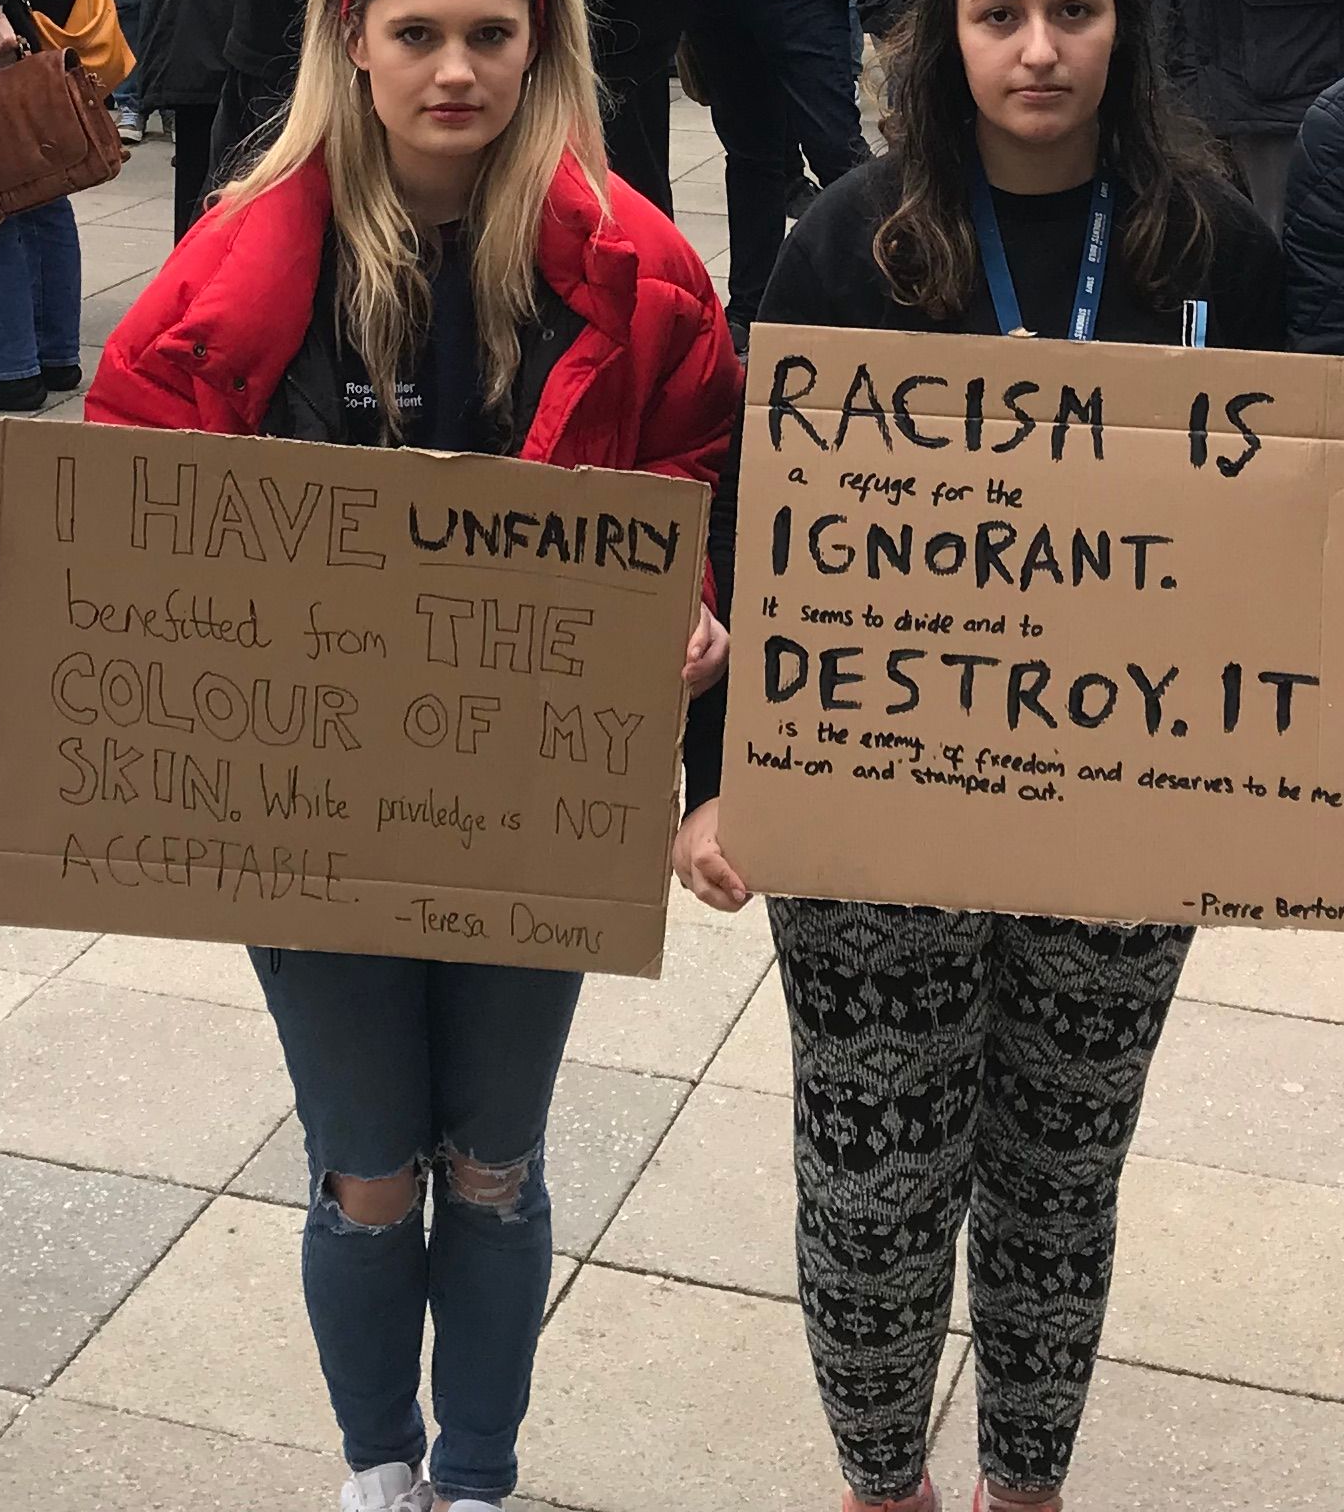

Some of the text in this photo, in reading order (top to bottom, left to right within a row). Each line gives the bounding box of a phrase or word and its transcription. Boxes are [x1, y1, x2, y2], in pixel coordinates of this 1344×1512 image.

[767, 355, 1275, 477] RACISM IS
[56, 456, 681, 575] I HAVE UNFAIRLY
[788, 466, 1023, 509] a refuge for the
[772, 505, 1177, 592] IGNORANT.
[67, 569, 594, 676] benefitted from THE
[762, 595, 1044, 638] It seems to divide and to
[51, 652, 645, 776] COLOUR OF MY
[57, 737, 641, 850] SKIN. White priviledge is NOT
[747, 741, 1065, 802] head-on and stamped out.
[778, 718, 799, 738] is
[817, 721, 849, 745] the
[859, 731, 925, 763] enemy
[942, 744, 964, 771] of
[975, 747, 1066, 778] freedom
[1077, 761, 1123, 783] and
[1137, 767, 1234, 795] deserves
[1242, 775, 1268, 798] to
[1277, 776, 1302, 801] be
[61, 833, 360, 904] ACCEPTABLE.
